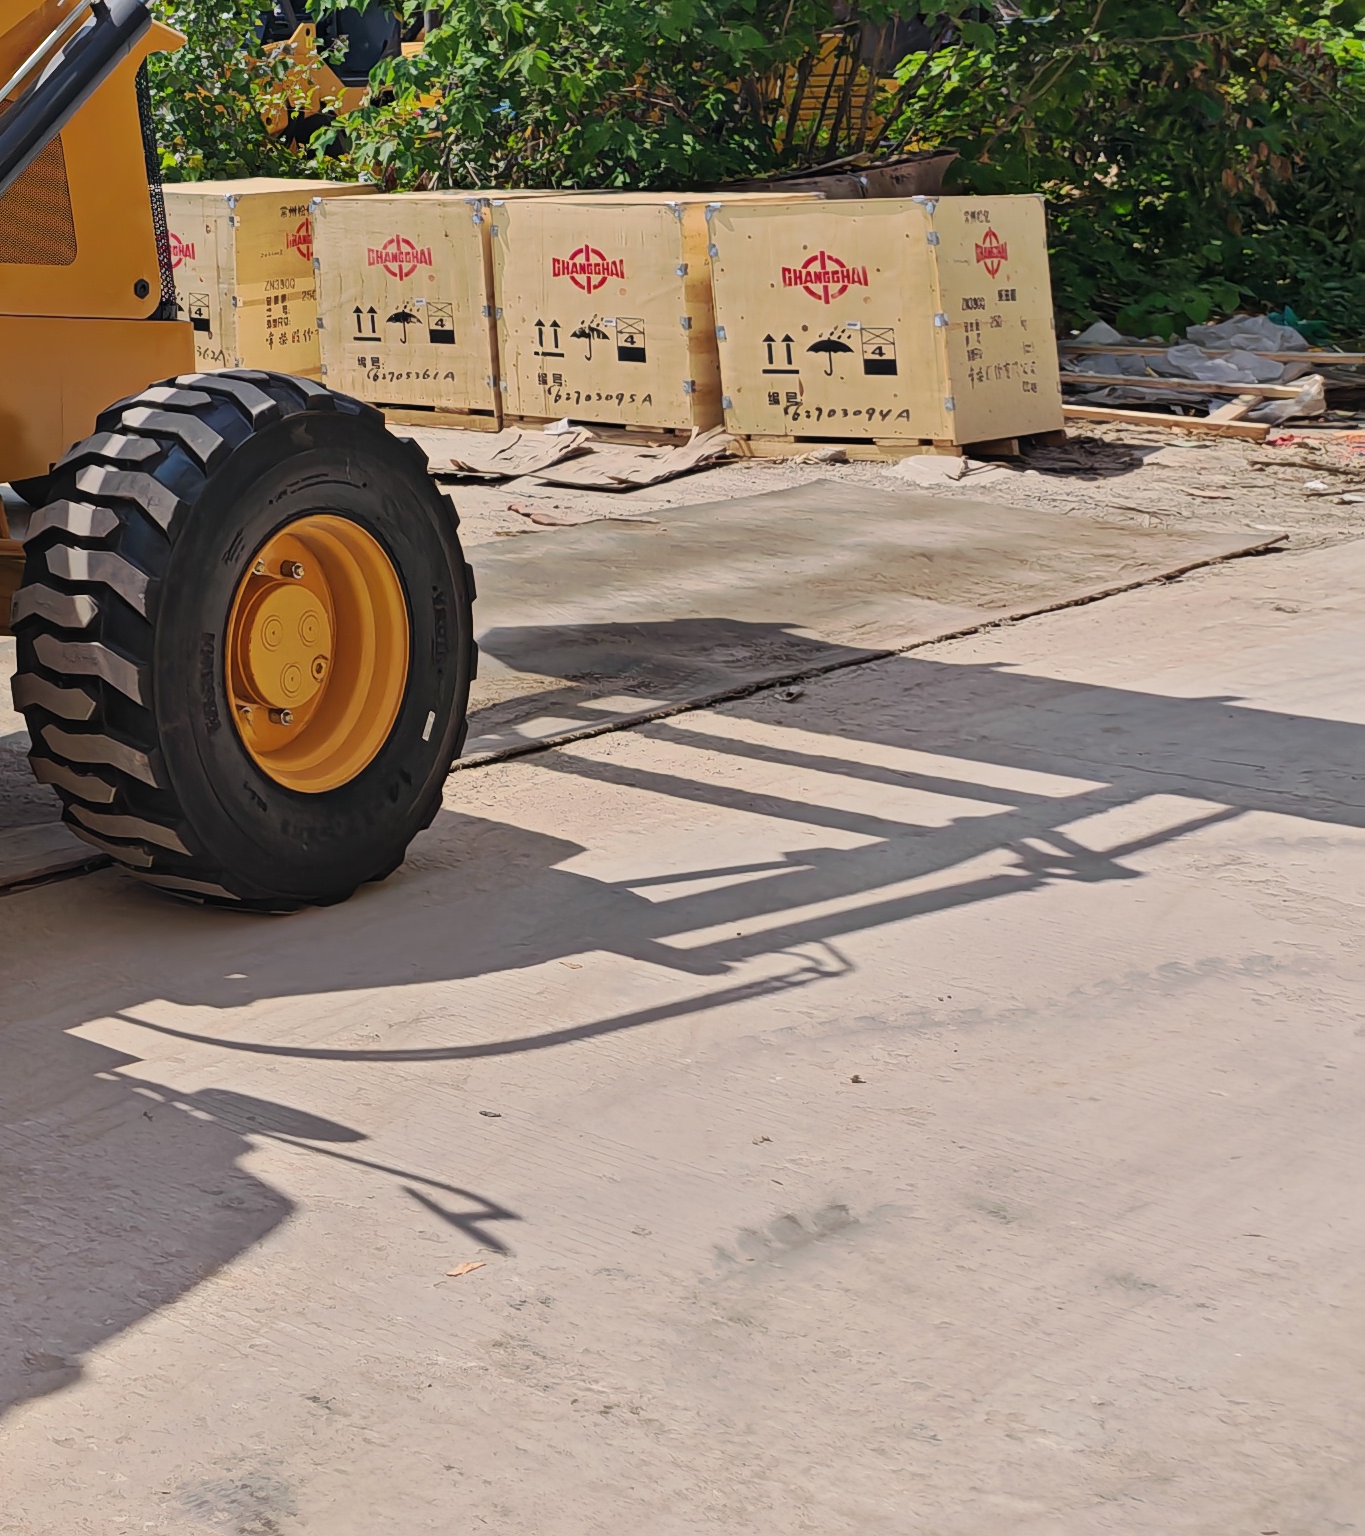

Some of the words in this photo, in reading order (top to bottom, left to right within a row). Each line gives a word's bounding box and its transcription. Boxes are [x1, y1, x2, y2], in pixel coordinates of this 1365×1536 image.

[194, 307, 204, 317] 4
[434, 317, 447, 329] 4
[623, 334, 637, 346] 4
[870, 345, 886, 358] 4
